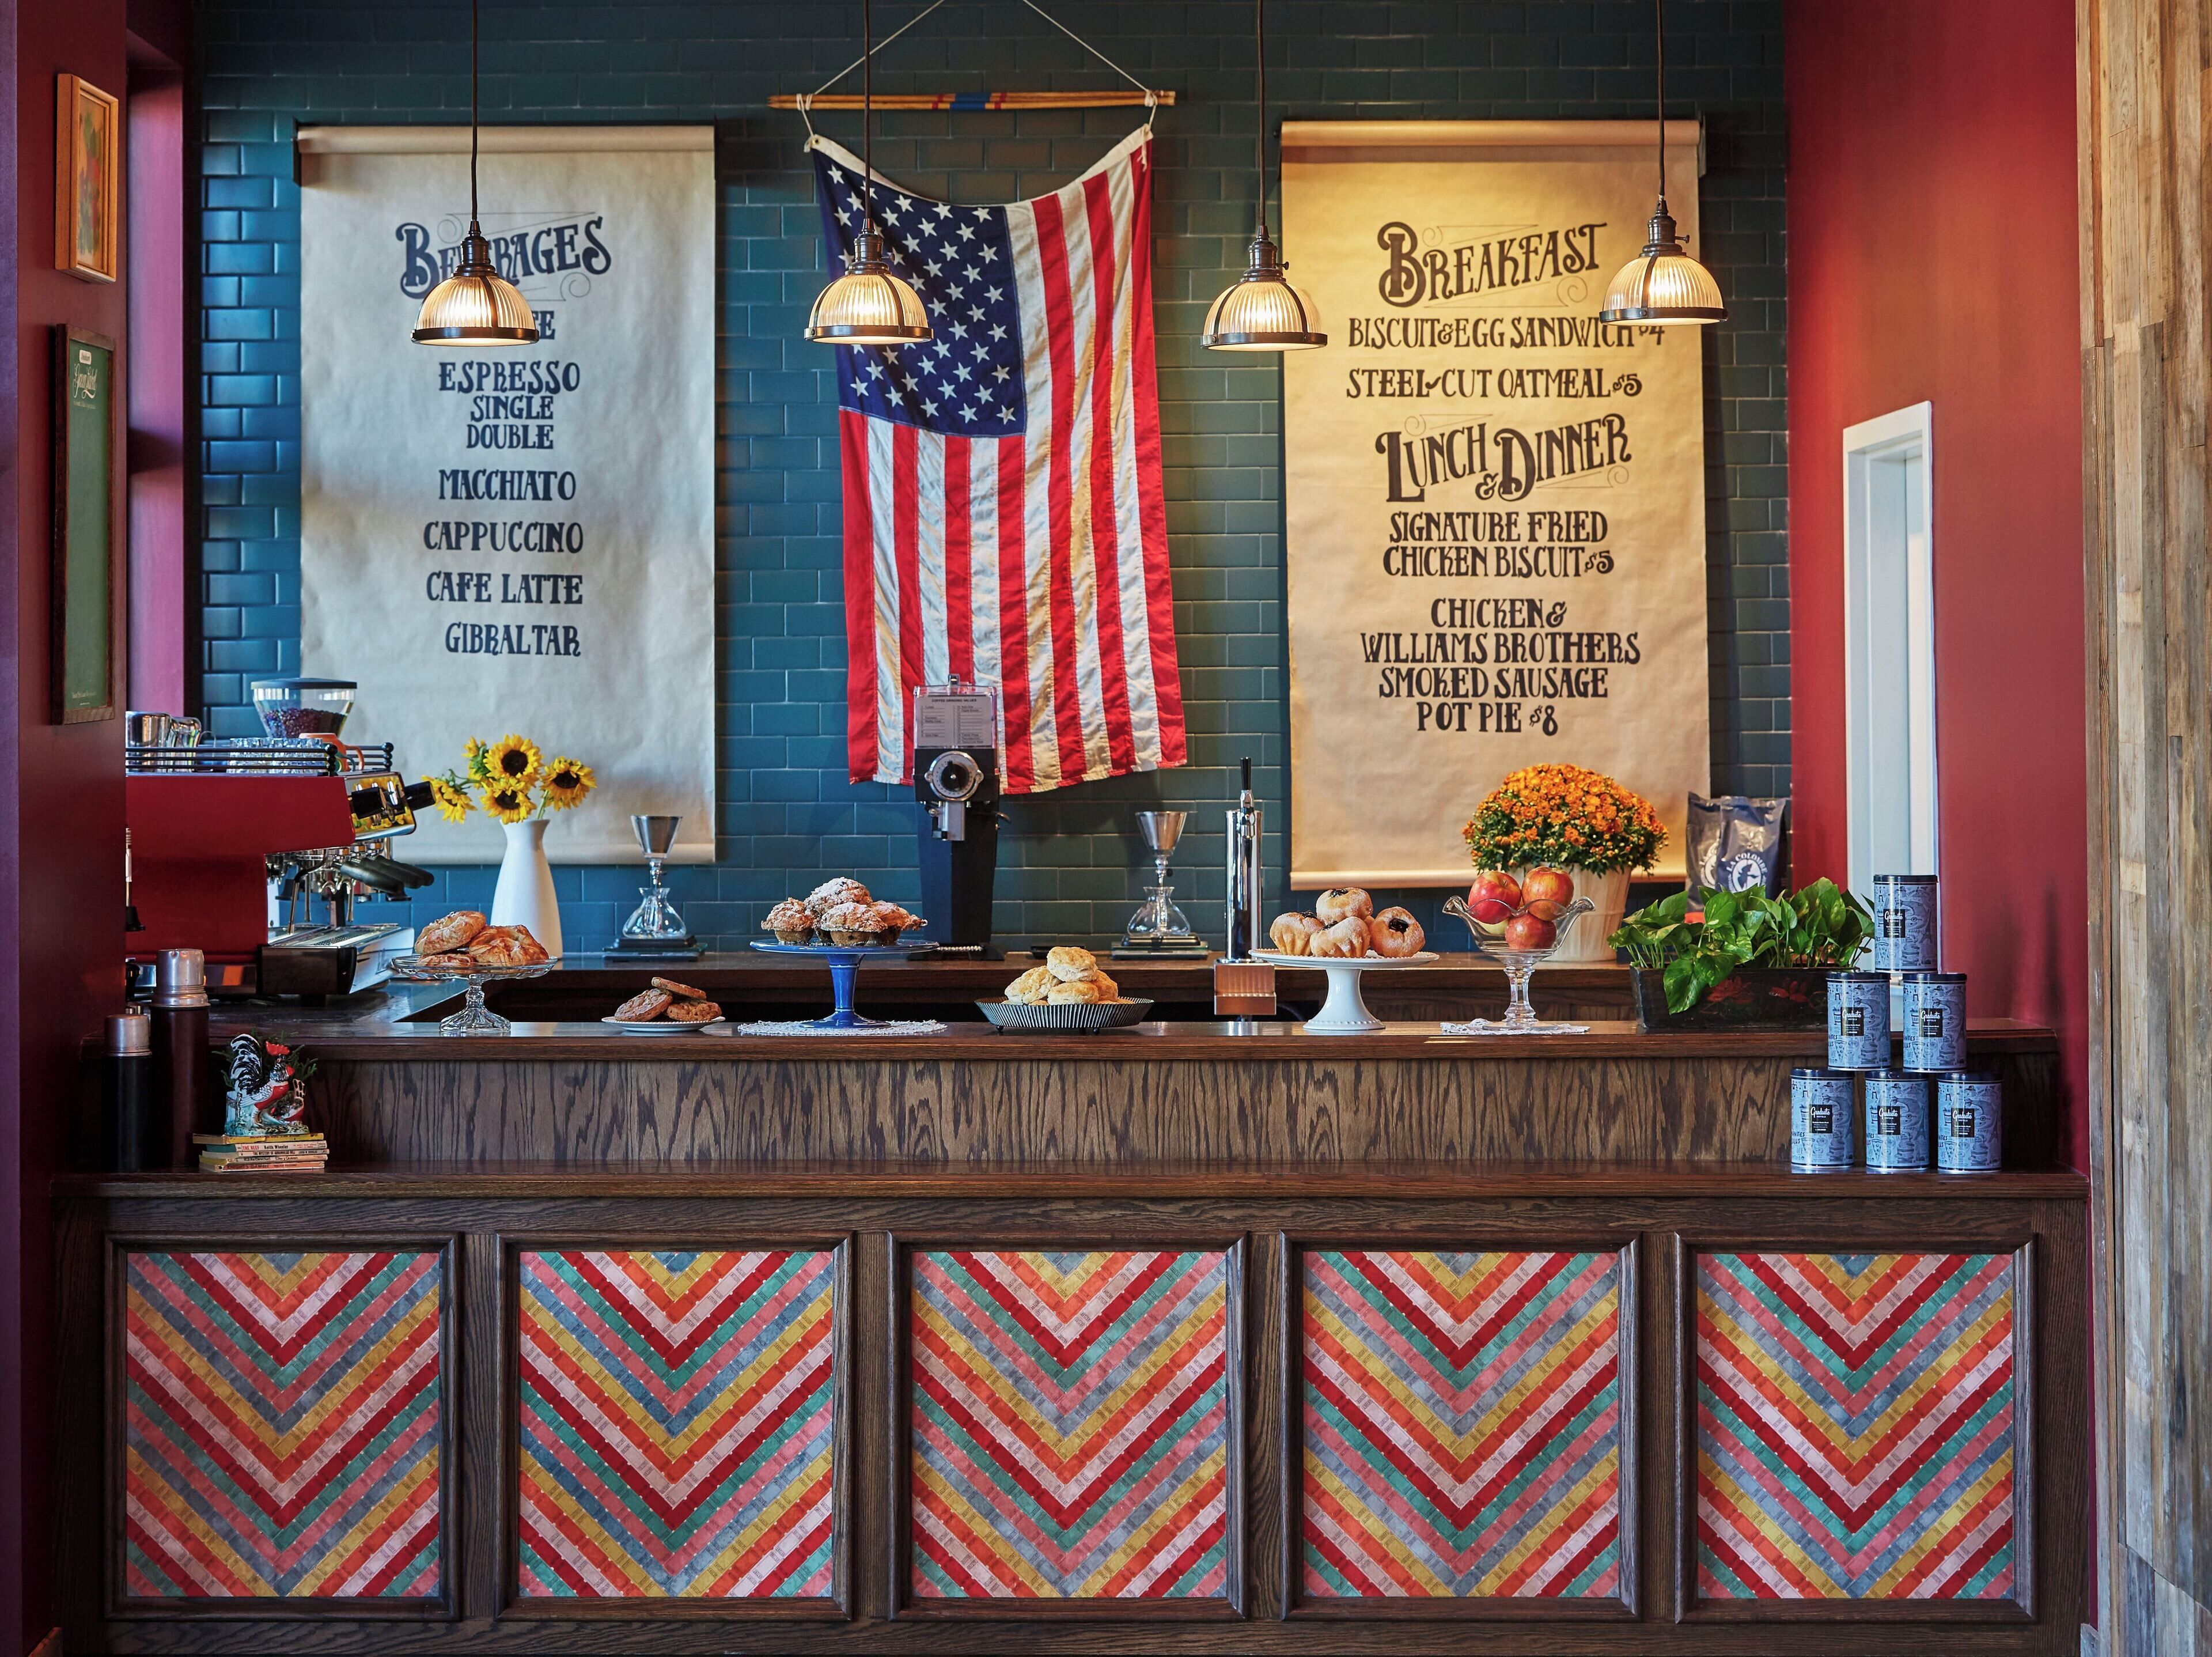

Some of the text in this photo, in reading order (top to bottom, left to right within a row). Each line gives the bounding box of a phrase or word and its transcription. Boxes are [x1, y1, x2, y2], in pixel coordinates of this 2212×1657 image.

[395, 216, 612, 300] BERAGES
[1377, 221, 1607, 308] BREAKFAST
[1510, 316, 1635, 349] SANDWICH
[439, 360, 580, 395] ESPRESSO
[1497, 366, 1612, 399] OATMEAL
[471, 395, 554, 422] SINGLE
[466, 424, 554, 449] DOUBLE
[1374, 413, 1633, 502] LUNCH & DINNER
[439, 469, 576, 501] MACCHIATO
[423, 521, 584, 554] CAPPUCCINO
[1389, 511, 1608, 543] SIGNATURE FRIED
[1383, 544, 1488, 577] CHICKEN
[1493, 545, 1585, 578] BISCUIT
[427, 570, 582, 604] CAFE LATTE
[1431, 598, 1568, 629] CHICKEN &
[445, 622, 581, 657] GIBRALTAR
[1361, 632, 1641, 665] WILLIAMS BROTHERS
[1379, 667, 1608, 699] SMOKED SAUSAGE
[1416, 702, 1472, 732] POT
[1479, 702, 1521, 733] PIE
[1726, 861, 1736, 872] LA
[1735, 852, 1768, 873] COLOMBE
